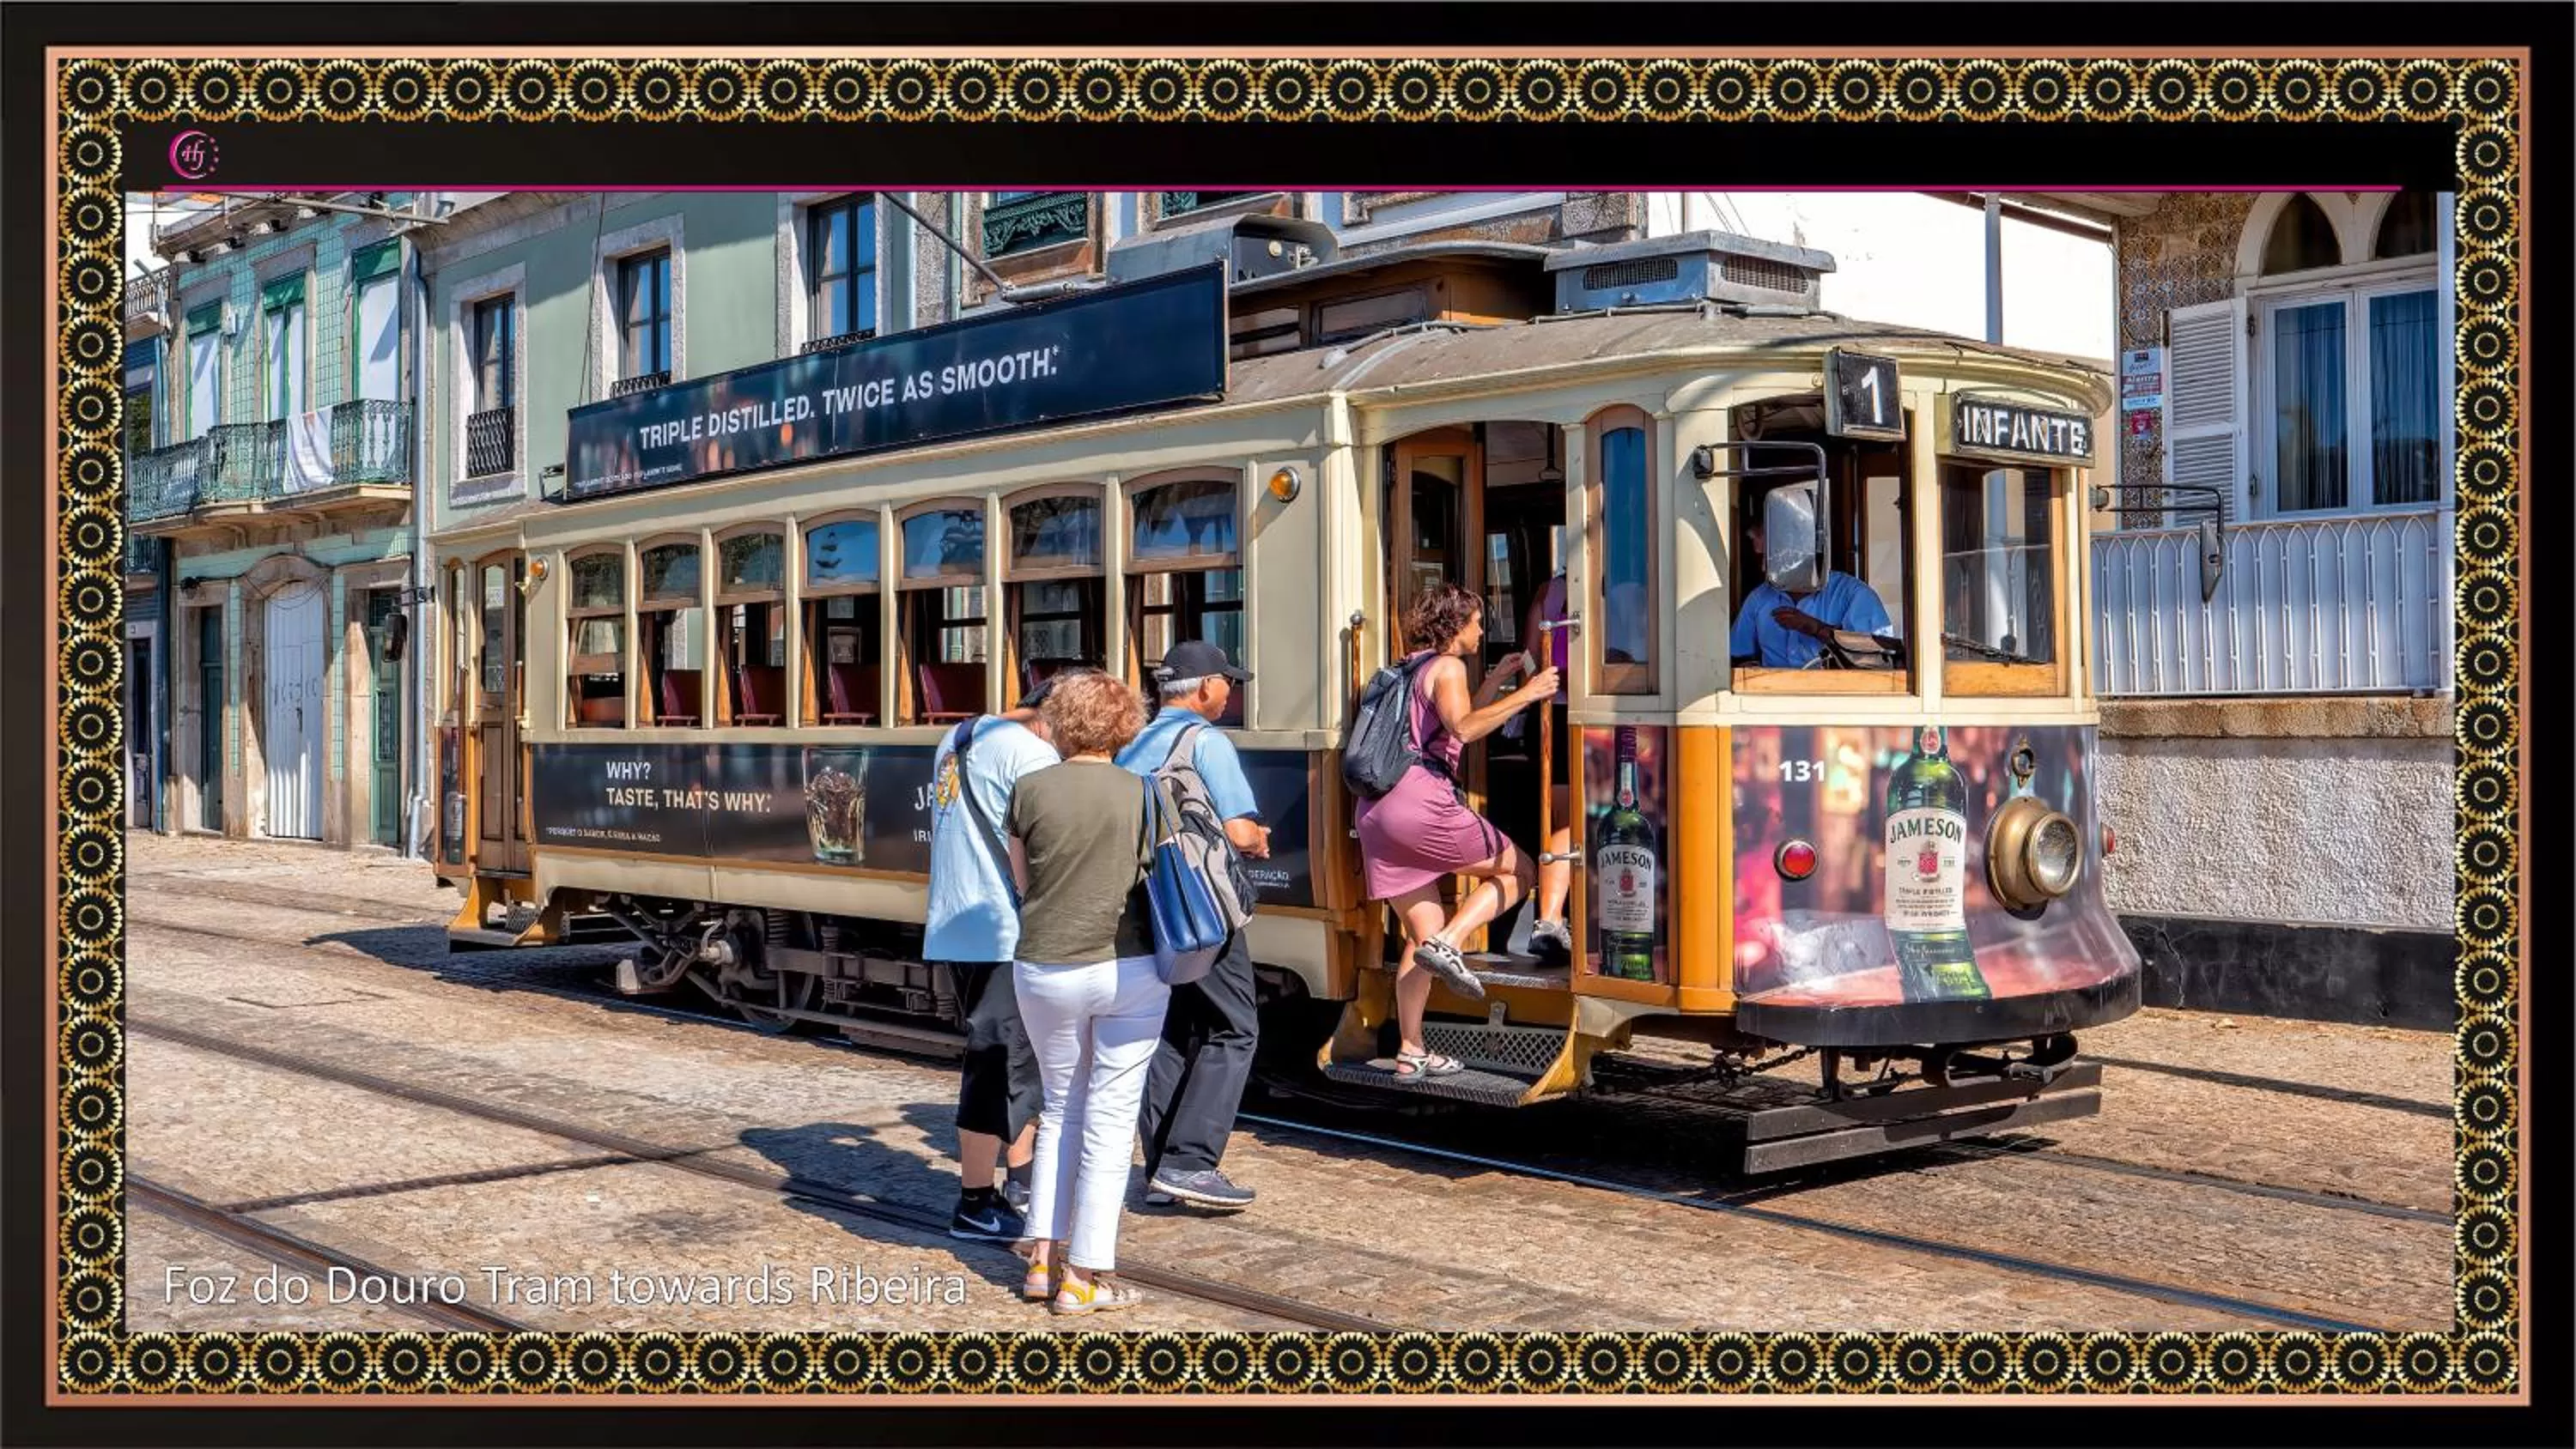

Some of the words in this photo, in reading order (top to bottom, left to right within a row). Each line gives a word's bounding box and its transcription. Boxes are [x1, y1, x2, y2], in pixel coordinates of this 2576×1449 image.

[1861, 367, 1883, 425] 1
[640, 414, 703, 451] TRIPLE
[708, 395, 815, 438] DISTILLED.
[822, 377, 895, 415] TWICE
[900, 369, 934, 403] AS
[1963, 405, 2085, 455] INFANTE
[606, 761, 652, 780] WHY?
[1779, 761, 1826, 782] 131
[606, 787, 659, 810] TASTE,
[662, 790, 720, 810] THAT'S
[1890, 817, 1963, 846] JAMESON
[1601, 851, 1652, 871] JAMESON
